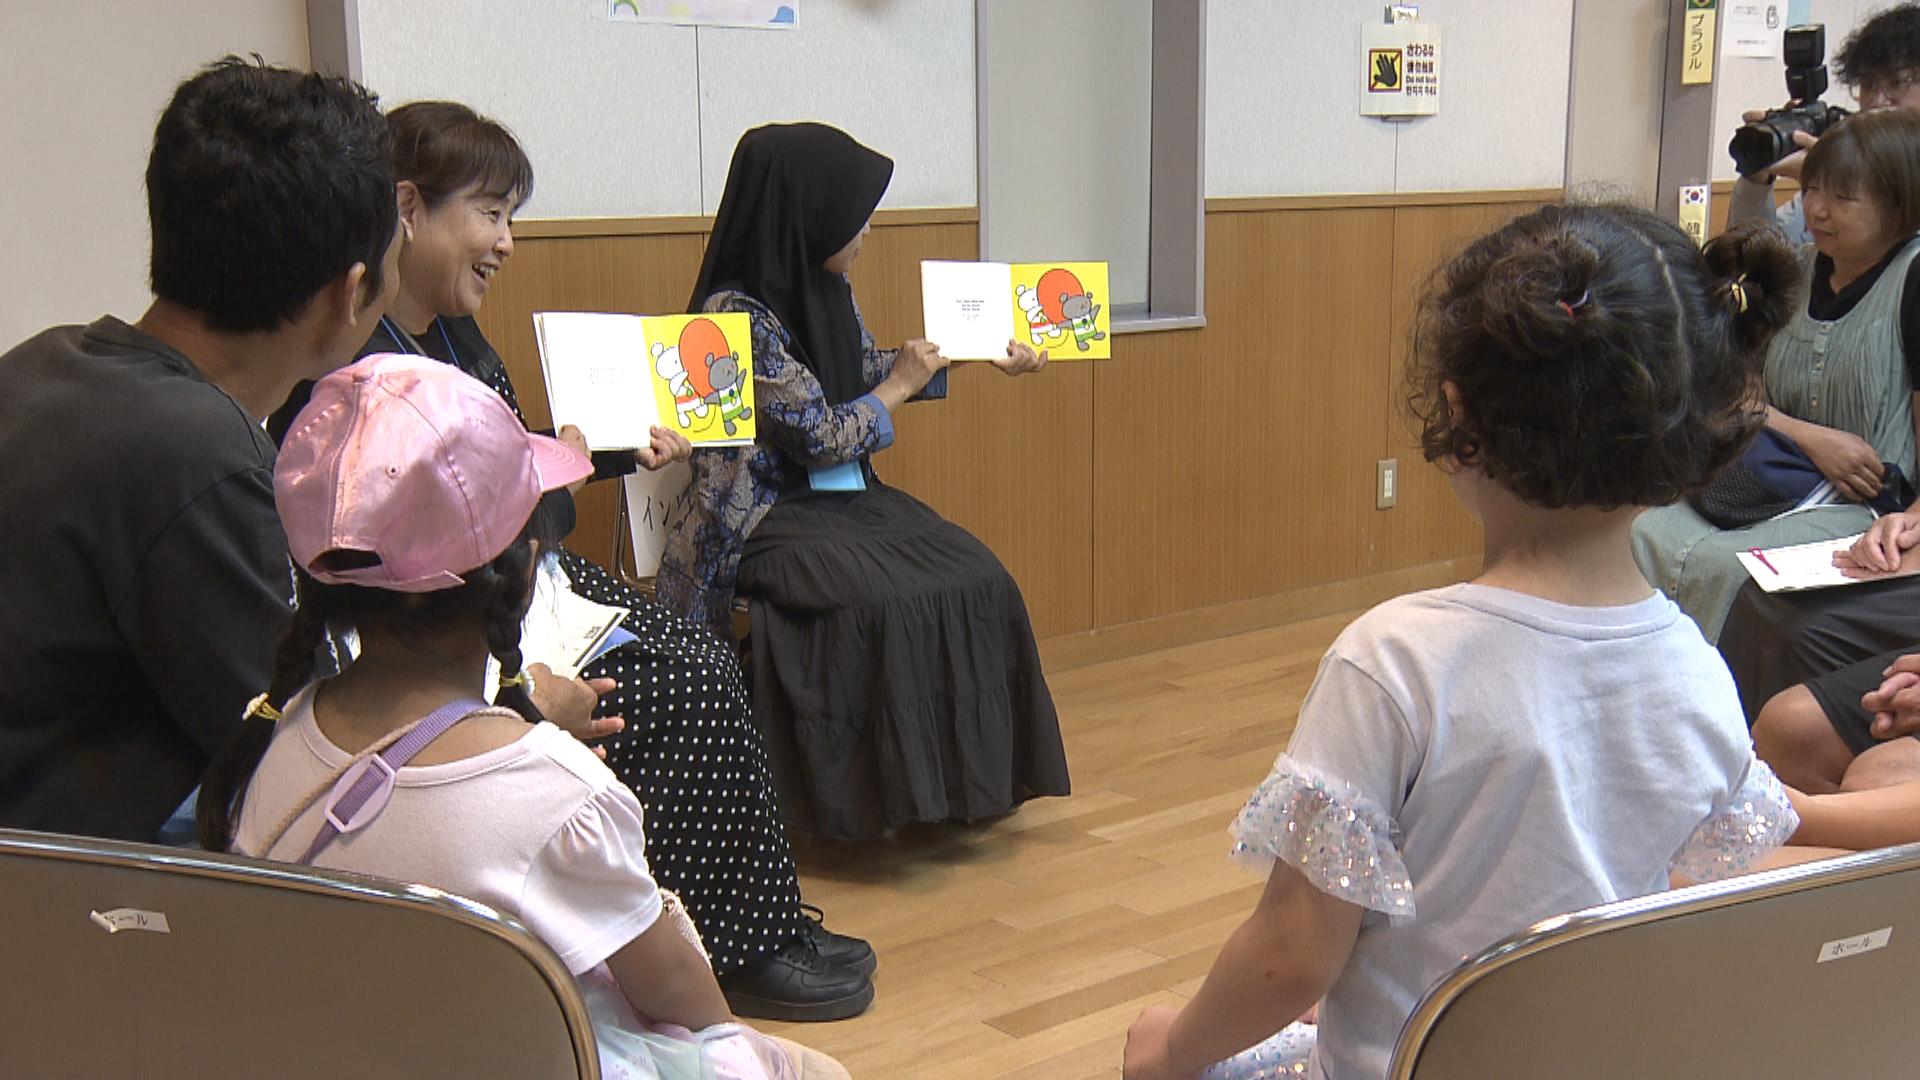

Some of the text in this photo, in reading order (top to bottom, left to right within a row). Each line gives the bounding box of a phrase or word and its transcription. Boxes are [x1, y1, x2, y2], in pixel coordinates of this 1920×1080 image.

[1406, 43, 1434, 57] さわるな
[1688, 13, 1705, 71] ブラジル
[1831, 936, 1872, 955] ホール
